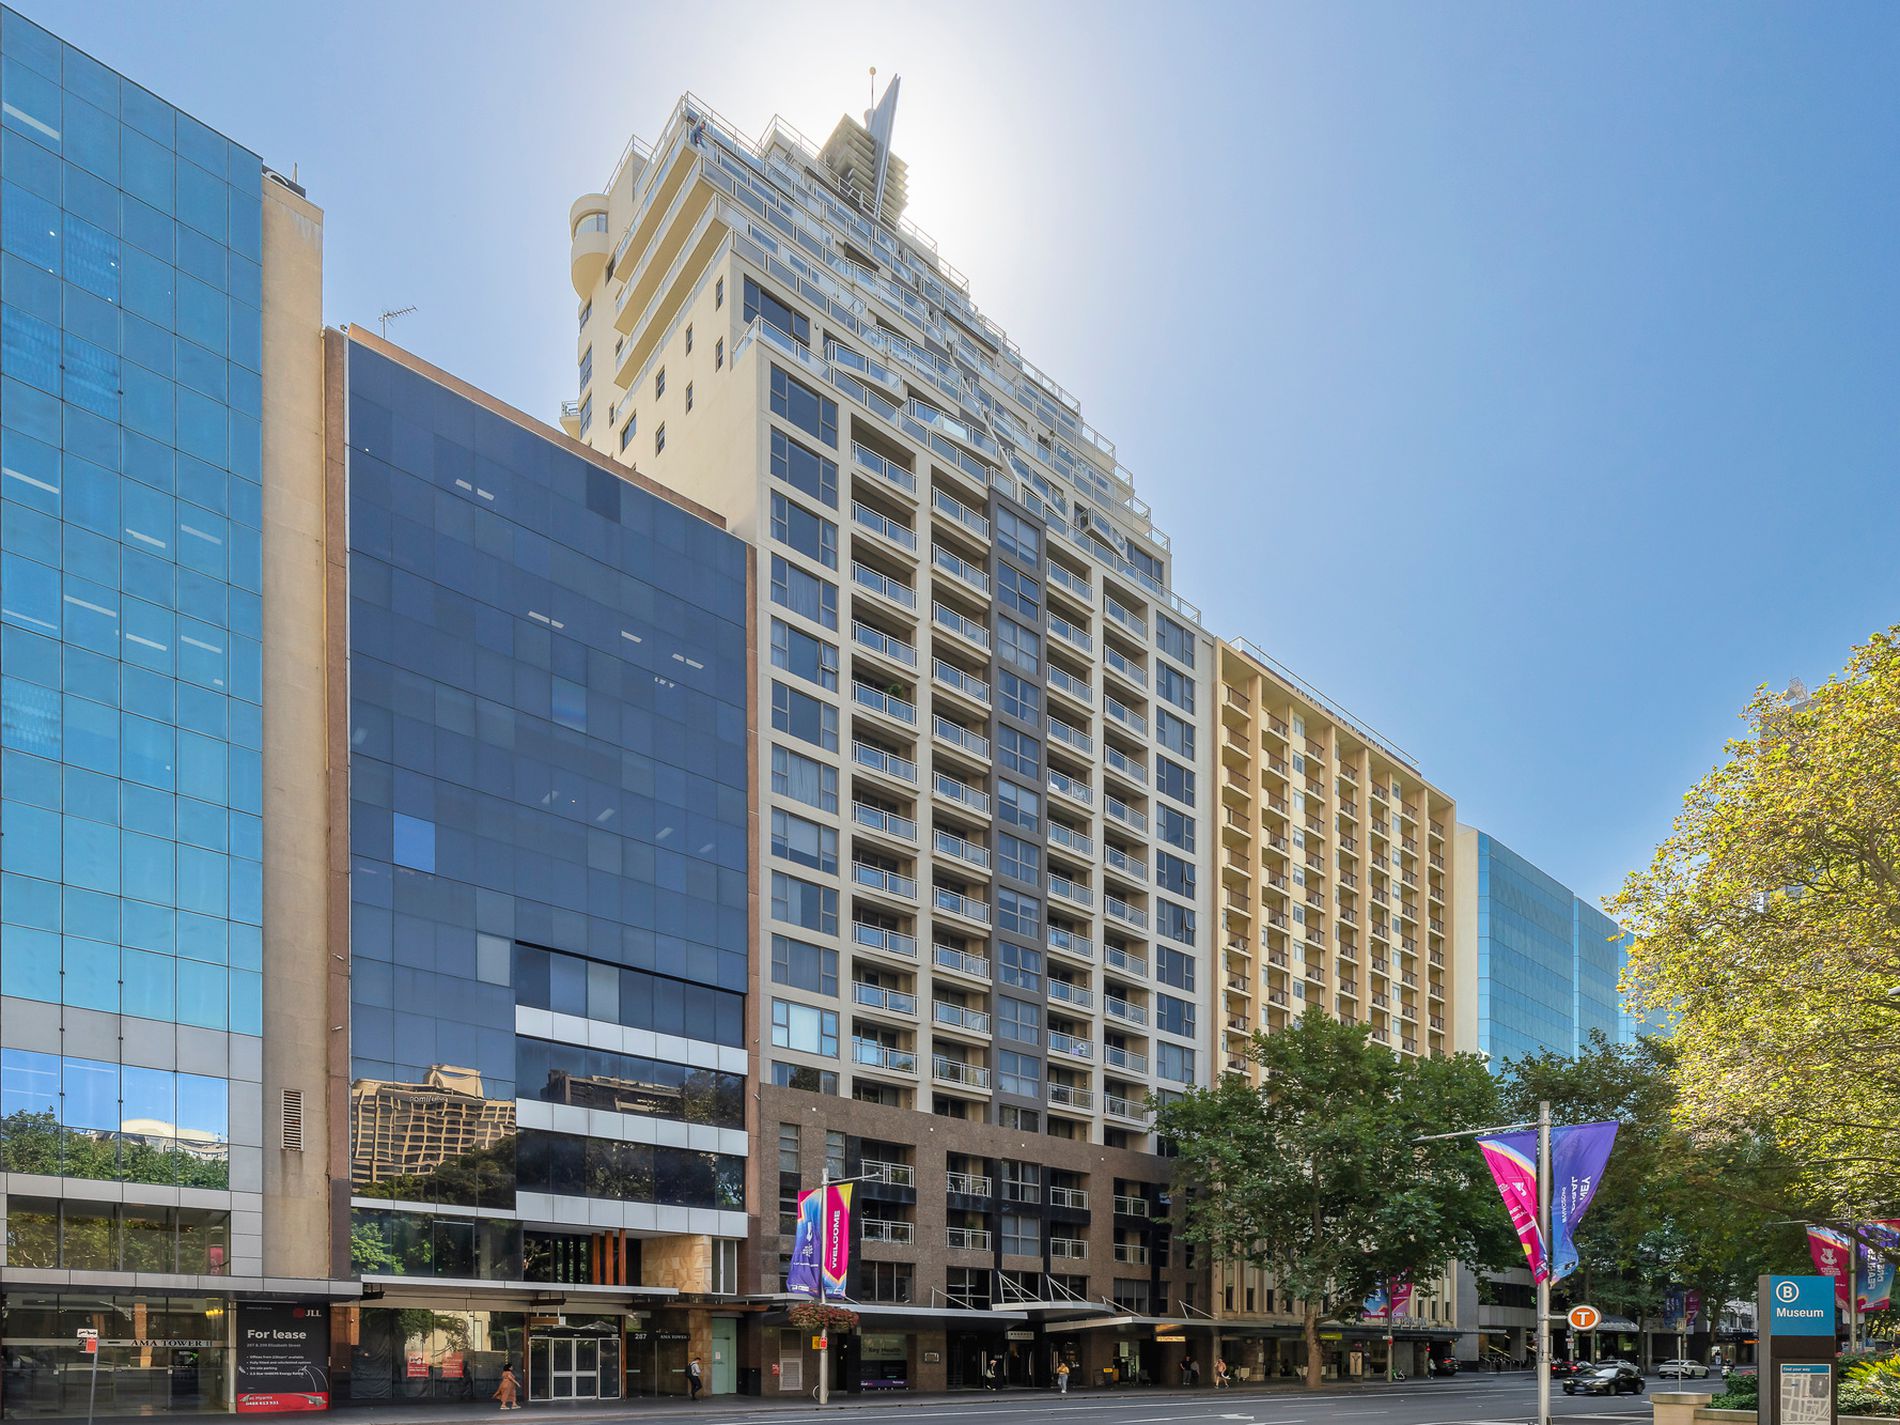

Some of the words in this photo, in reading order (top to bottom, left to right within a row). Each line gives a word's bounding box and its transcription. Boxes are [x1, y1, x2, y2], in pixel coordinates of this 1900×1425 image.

[832, 1210, 841, 1269] WELCOME
[1782, 1286, 1793, 1299] B
[305, 1309, 322, 1317] JLL
[1576, 1311, 1590, 1326] T
[1776, 1307, 1824, 1318] Museum
[247, 1329, 270, 1339] For
[273, 1329, 307, 1339] lease
